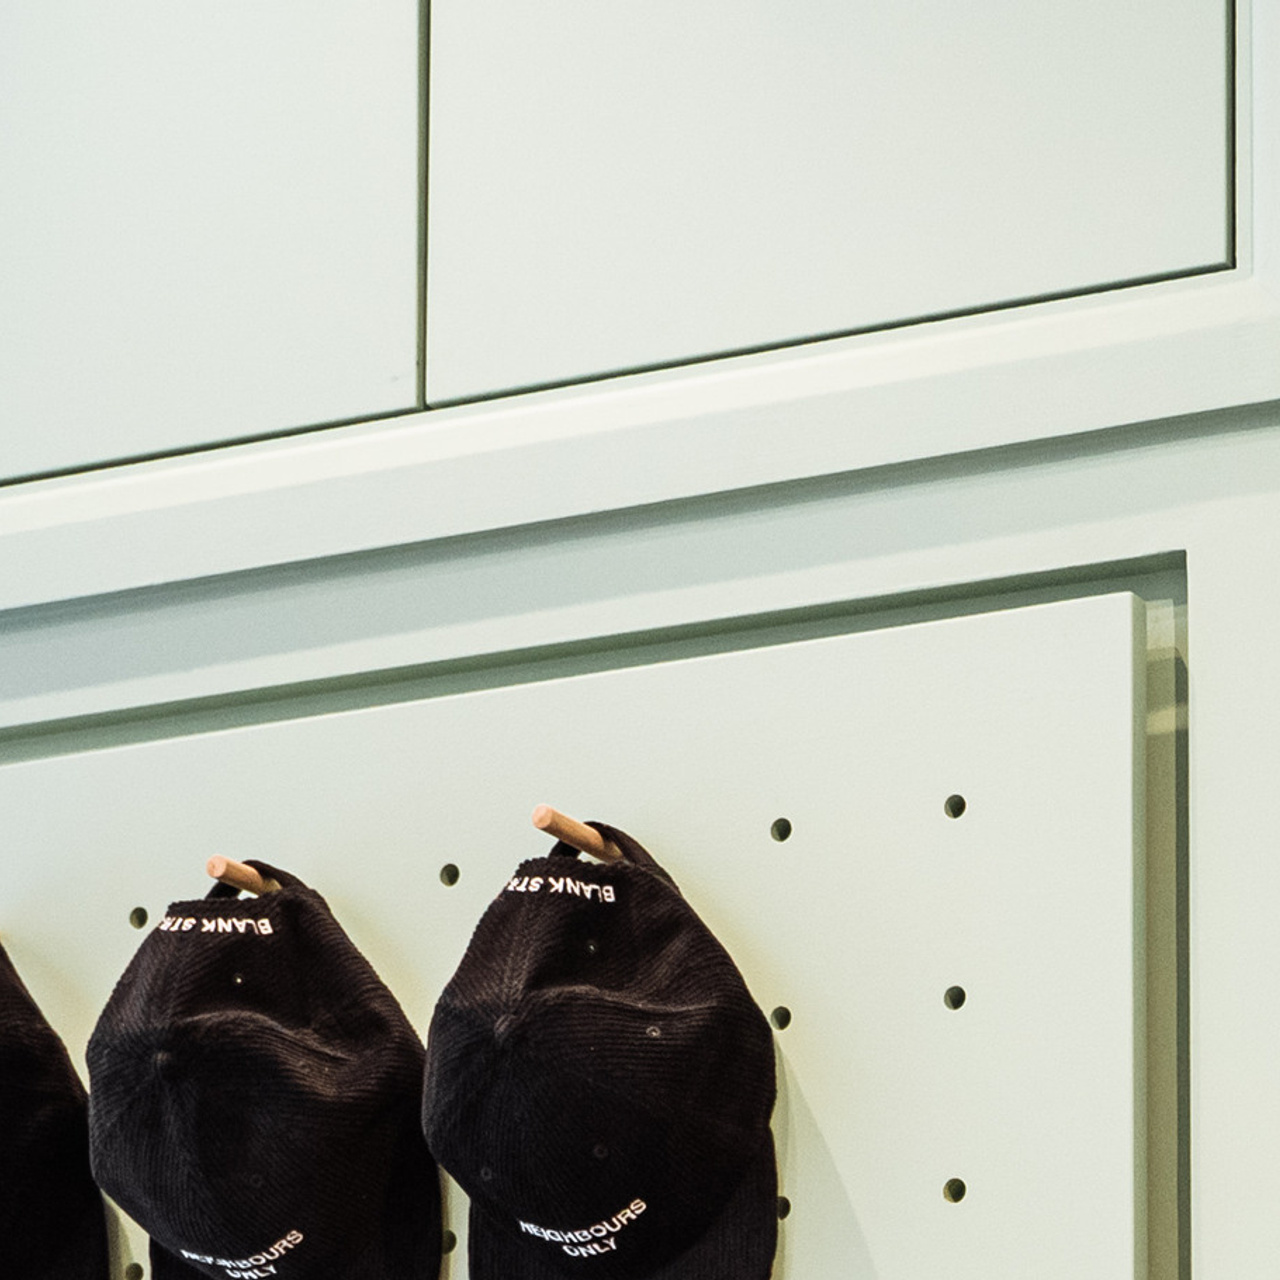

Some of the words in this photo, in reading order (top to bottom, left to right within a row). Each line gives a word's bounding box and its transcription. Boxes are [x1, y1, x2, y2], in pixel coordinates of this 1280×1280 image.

[548, 877, 616, 903] BLANK
[200, 916, 274, 936] BLANK
[518, 1198, 648, 1244] NEIGHBOURS
[562, 1237, 618, 1258] ONLY
[226, 1264, 277, 1280] ONLY
